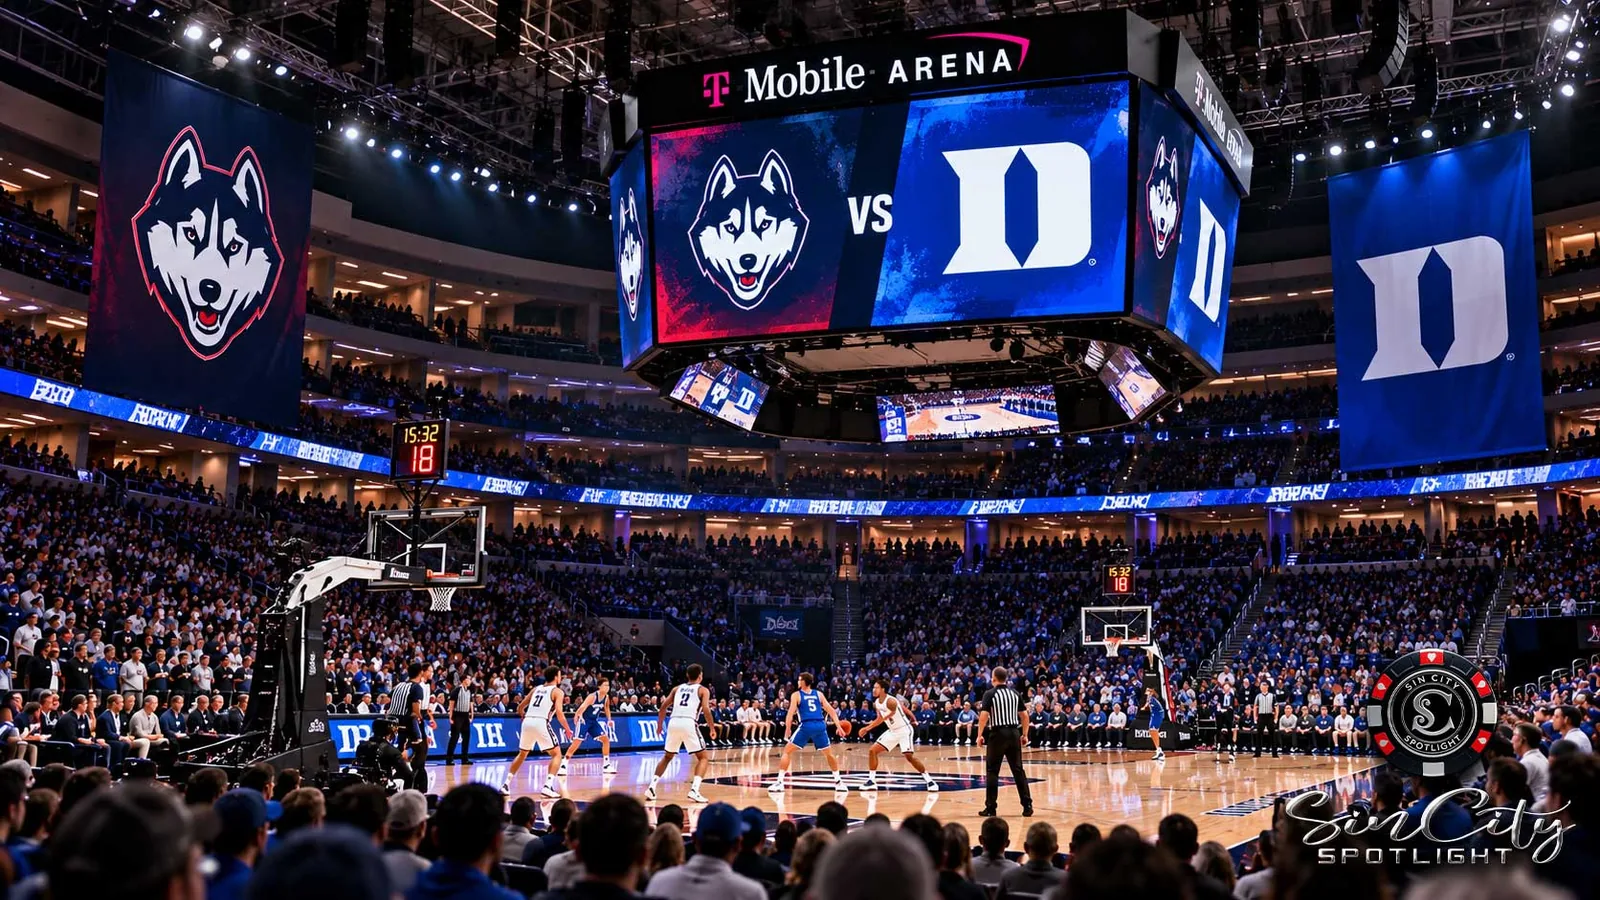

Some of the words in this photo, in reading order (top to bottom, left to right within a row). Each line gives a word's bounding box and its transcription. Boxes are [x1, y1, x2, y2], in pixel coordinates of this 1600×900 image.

[744, 55, 866, 103] Mobile
[888, 48, 1012, 84] ARENA
[847, 193, 894, 235] VS
[404, 424, 439, 444] 15:32
[412, 444, 434, 473] 18
[1115, 577, 1128, 592] 18
[679, 692, 691, 707] 2
[807, 700, 817, 712] 5
